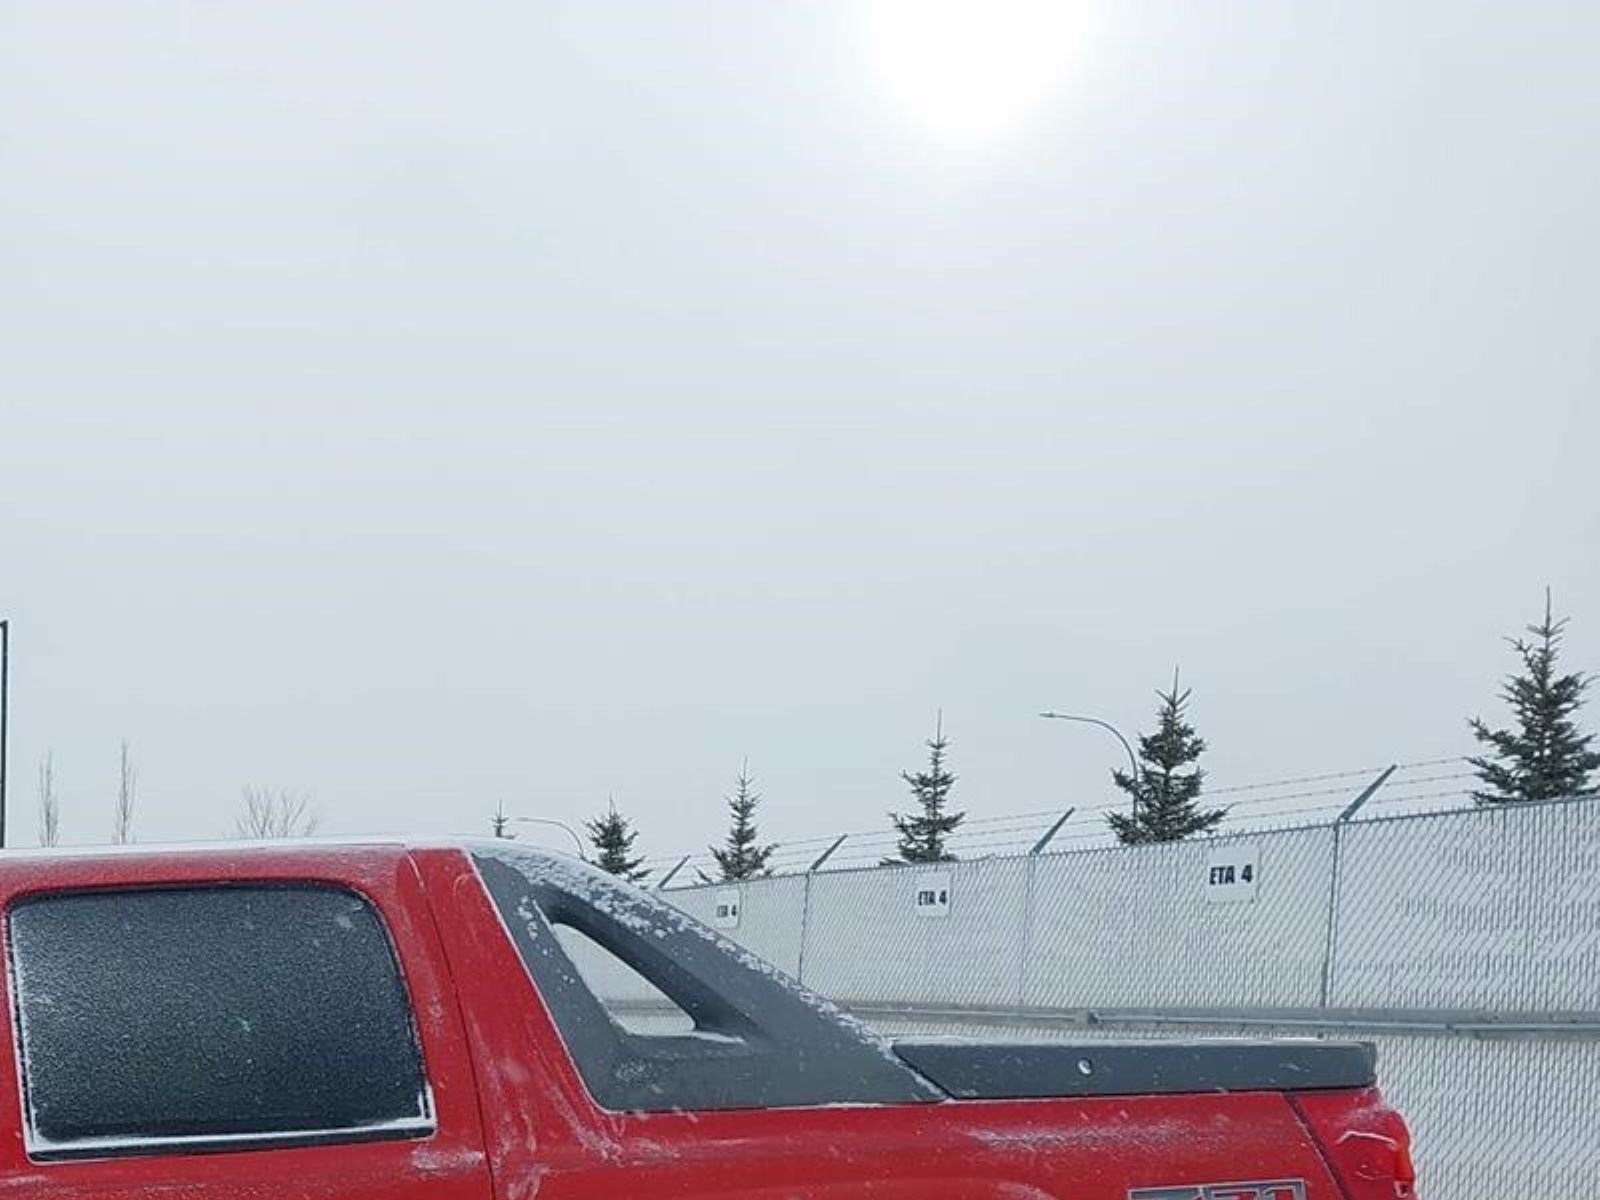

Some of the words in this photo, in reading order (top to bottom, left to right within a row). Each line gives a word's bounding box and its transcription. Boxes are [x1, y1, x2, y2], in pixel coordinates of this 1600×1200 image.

[1210, 865, 1235, 886] ETA
[1241, 864, 1253, 883] 4
[939, 890, 947, 905] 4
